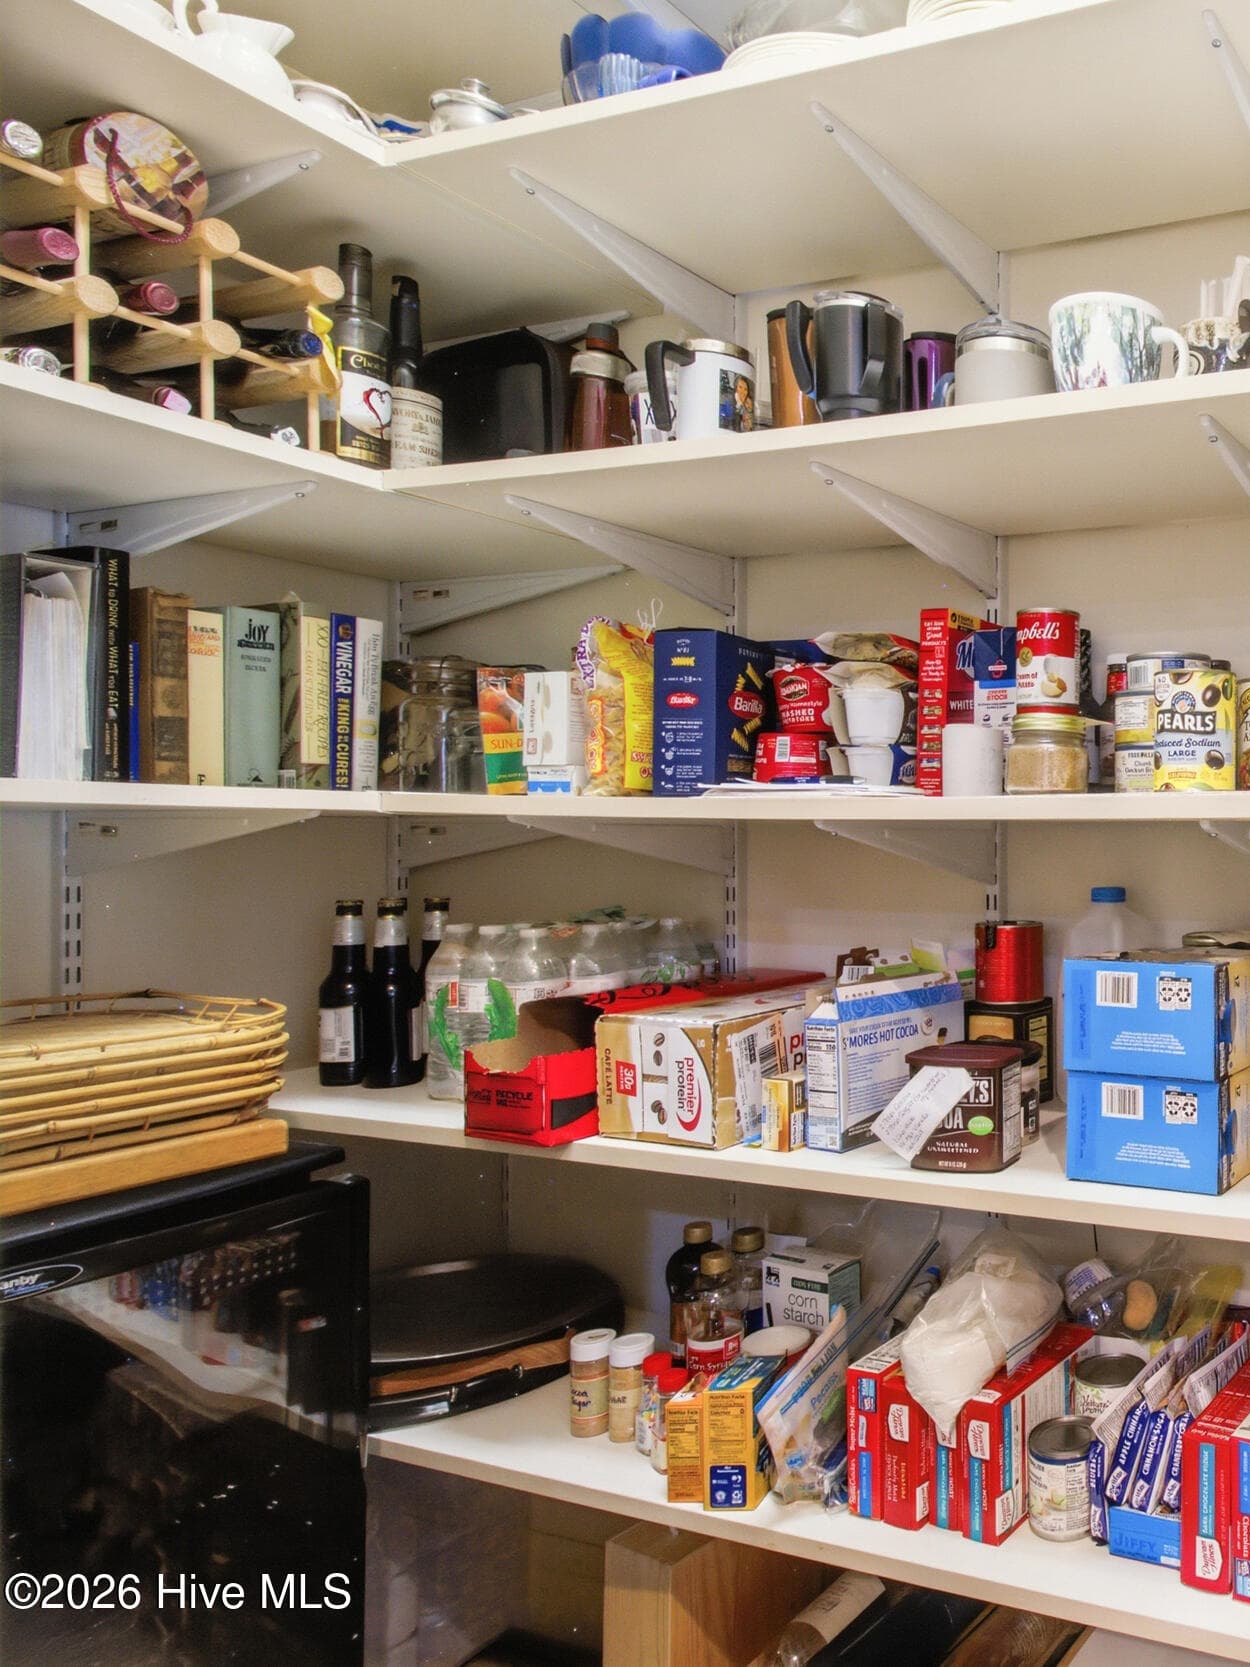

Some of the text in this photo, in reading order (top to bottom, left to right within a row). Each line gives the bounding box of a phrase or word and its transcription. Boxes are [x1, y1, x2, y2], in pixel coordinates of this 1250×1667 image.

[107, 559, 118, 588] WHAT
[107, 599, 118, 627] DRINK
[1017, 622, 1060, 644] mpbell's
[107, 646, 118, 673] WHAT
[335, 641, 352, 694] VINEGAR
[107, 690, 118, 708] EAT
[734, 697, 763, 714] Barilla
[949, 699, 974, 711] WHITE
[336, 704, 350, 734] KING
[1157, 713, 1215, 731] PEARLS
[1184, 738, 1221, 748] Sodium
[335, 744, 350, 789] CURES!
[842, 1024, 919, 1050] S'MORES HOT COCOA
[604, 1072, 613, 1105] LATTE
[675, 1059, 686, 1112] protein
[684, 1056, 694, 1115] premier
[0, 1272, 39, 1292] anby
[787, 1293, 818, 1309] corn
[783, 1308, 825, 1326] starch
[1153, 1412, 1166, 1434] SUGA
[1118, 1440, 1132, 1465] APPLE
[1113, 1533, 1158, 1551] JIFFY
[1242, 1516, 1250, 1557] Chocolate
